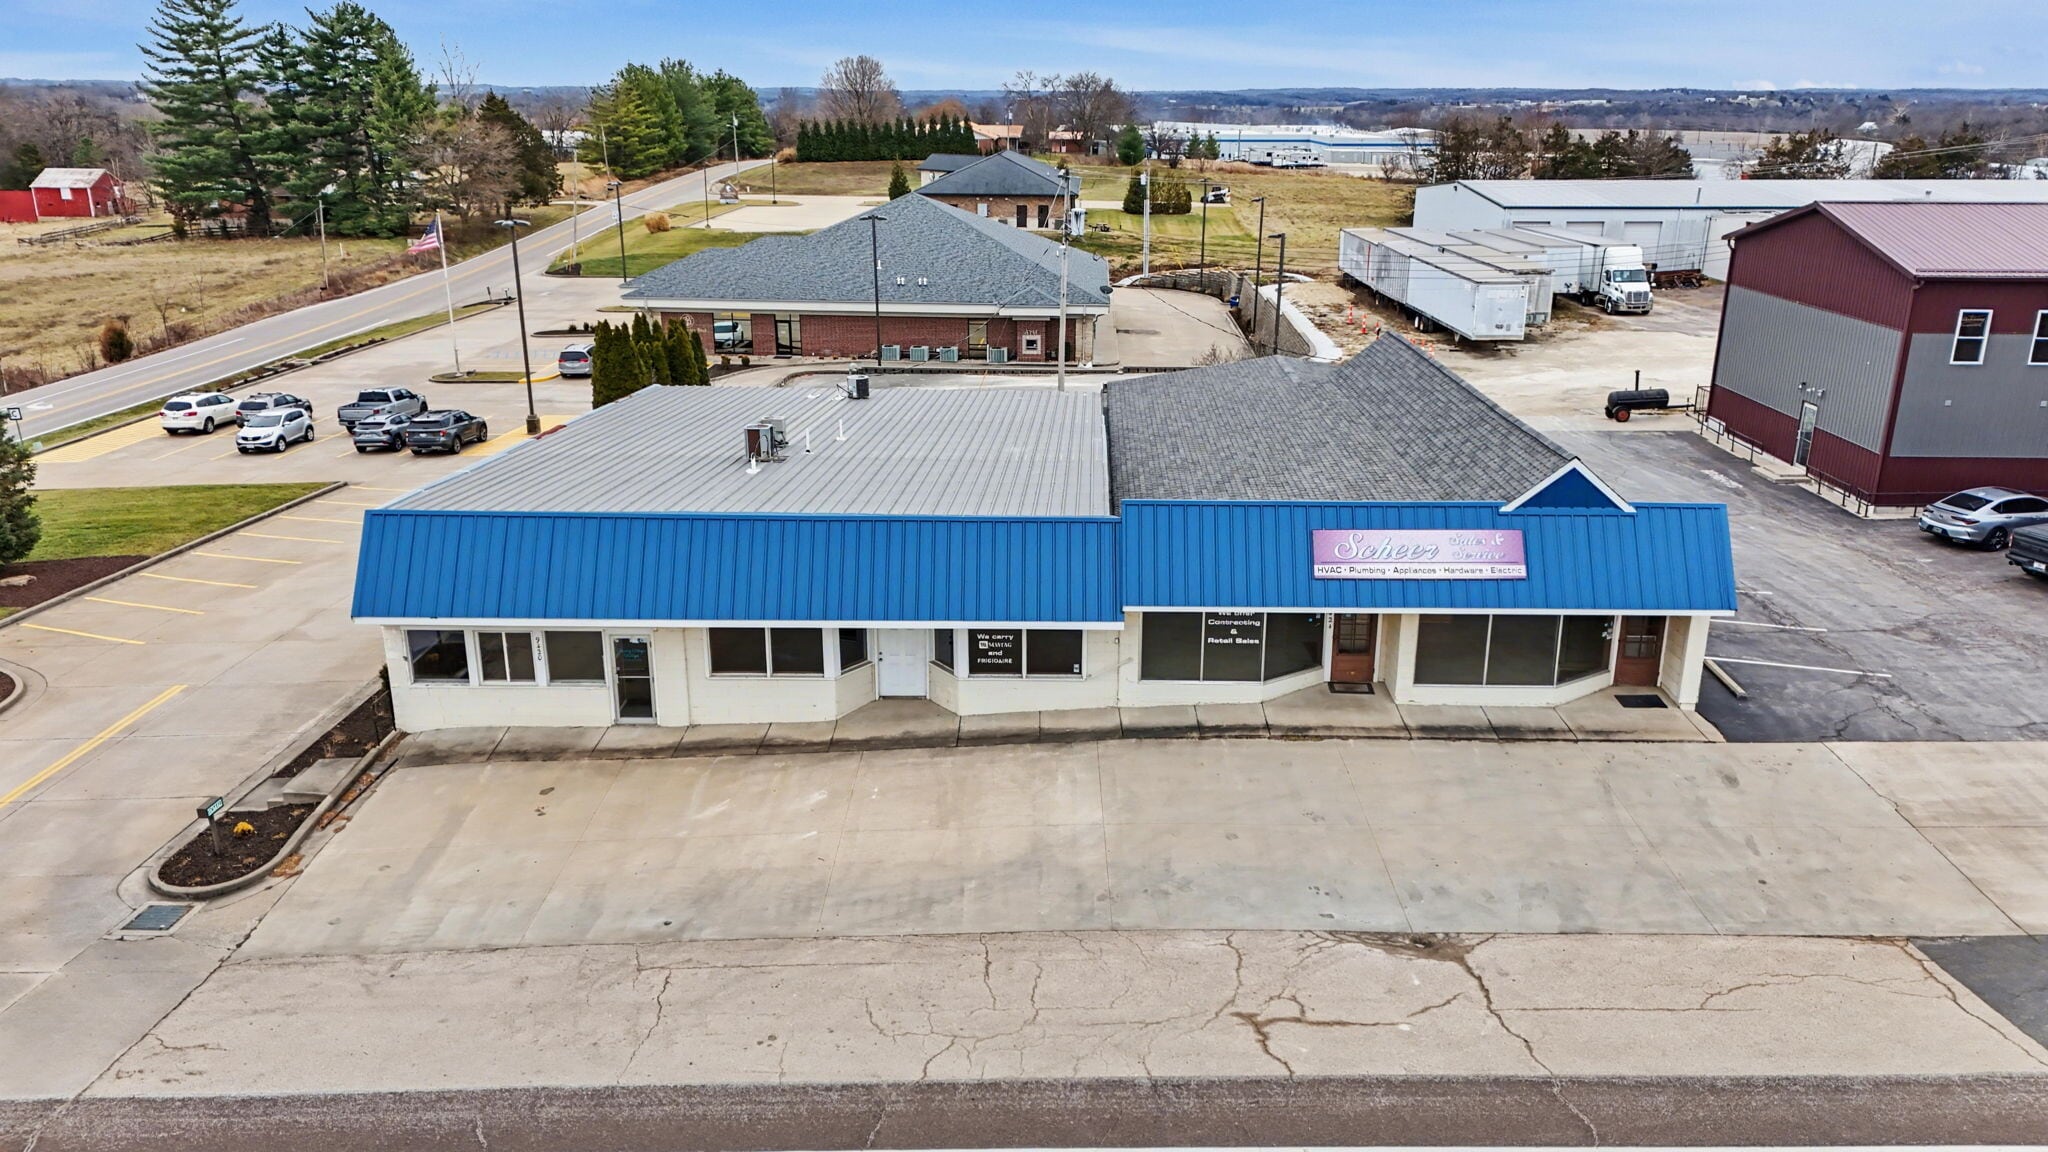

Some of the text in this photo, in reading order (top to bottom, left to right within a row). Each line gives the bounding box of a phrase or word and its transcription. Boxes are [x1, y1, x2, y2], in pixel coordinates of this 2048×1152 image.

[1449, 532, 1505, 546] Sales &
[1334, 532, 1440, 560] Scheer
[1452, 547, 1507, 560] Service
[1317, 566, 1523, 575] HVAC Plumbing Appliances Hardware Electric
[1208, 619, 1261, 627] Contracting
